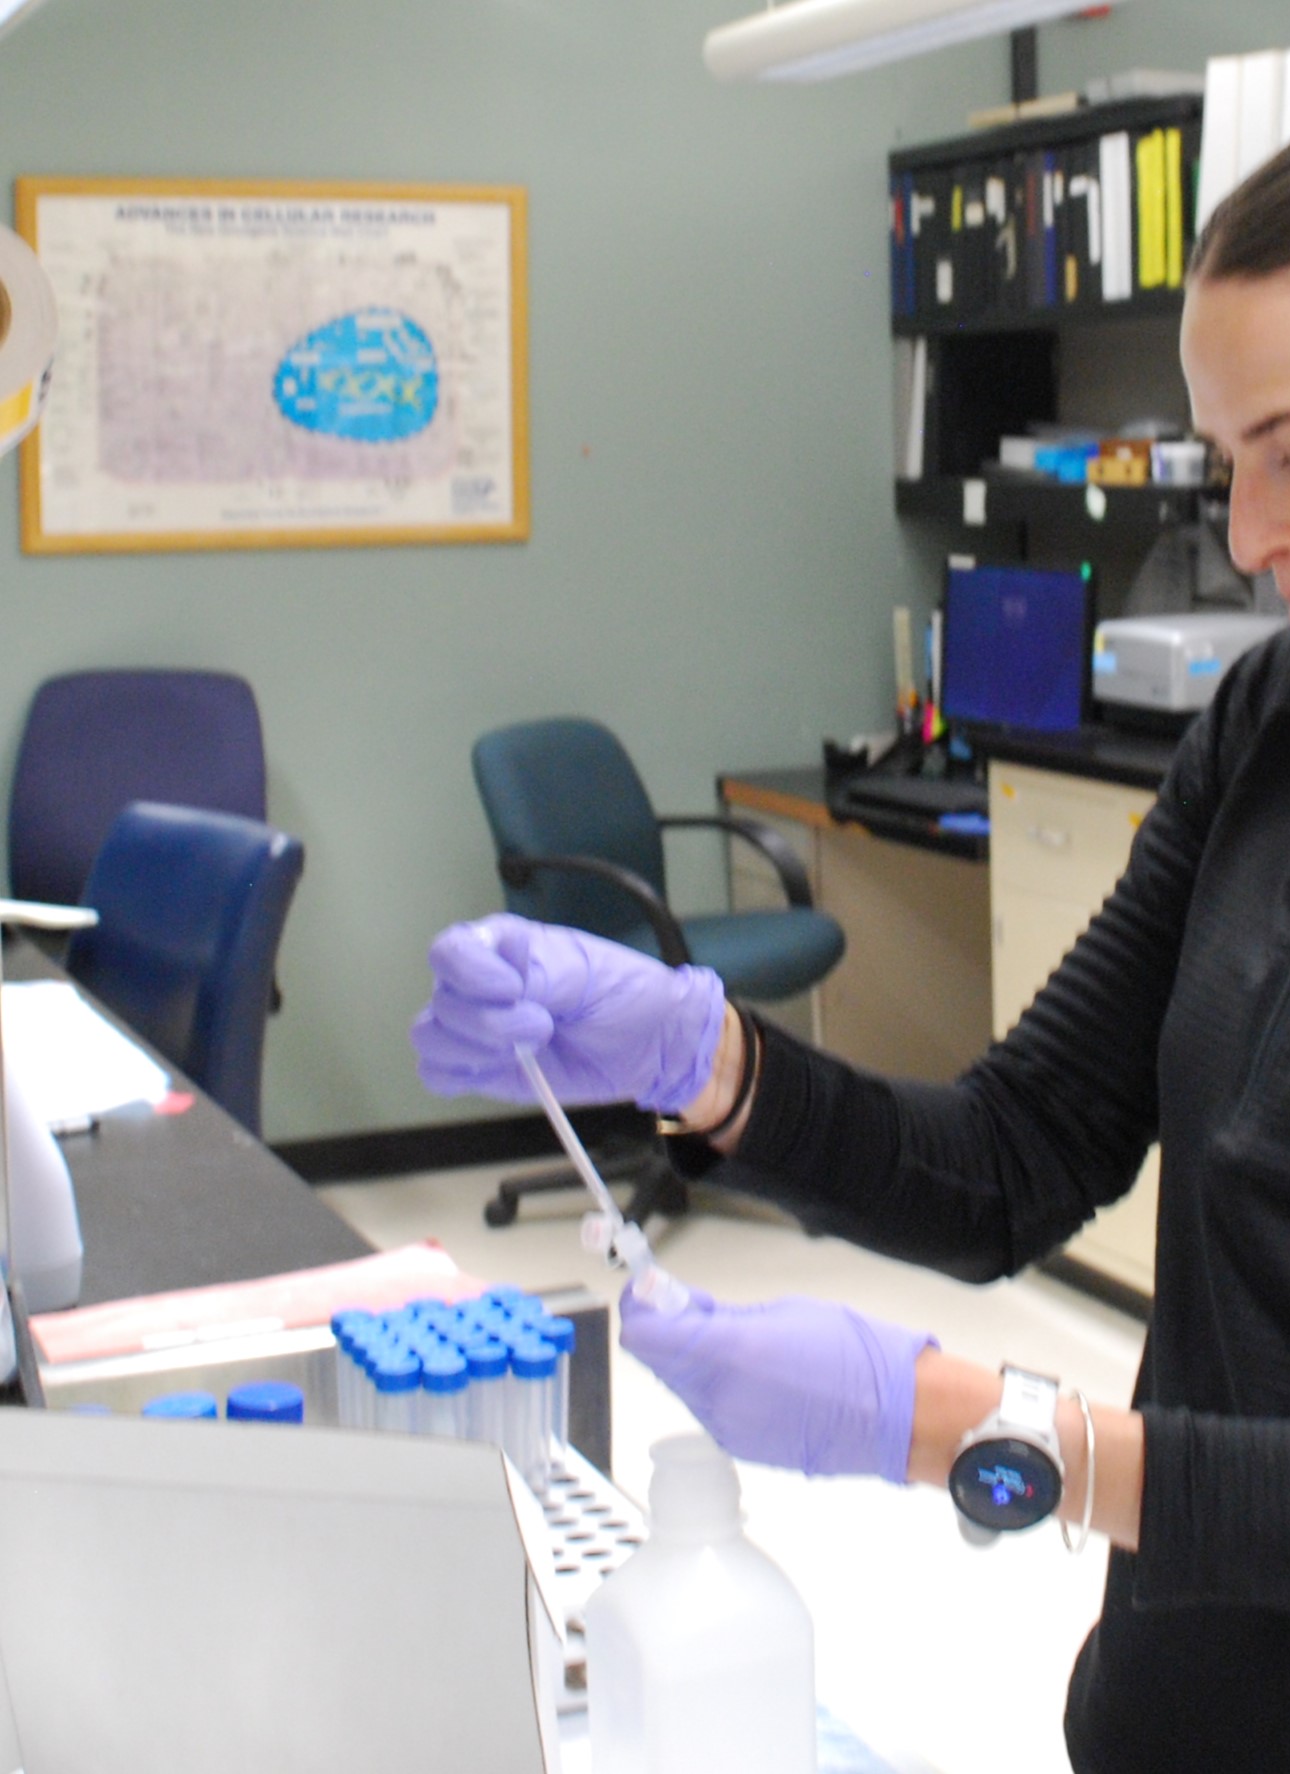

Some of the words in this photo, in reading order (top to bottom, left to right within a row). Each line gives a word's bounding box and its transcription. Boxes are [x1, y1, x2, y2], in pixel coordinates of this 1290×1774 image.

[115, 205, 212, 221] ADVANCES
[219, 206, 235, 222] IN
[241, 206, 334, 223] CELLULAR
[341, 208, 436, 225] RESEARCH
